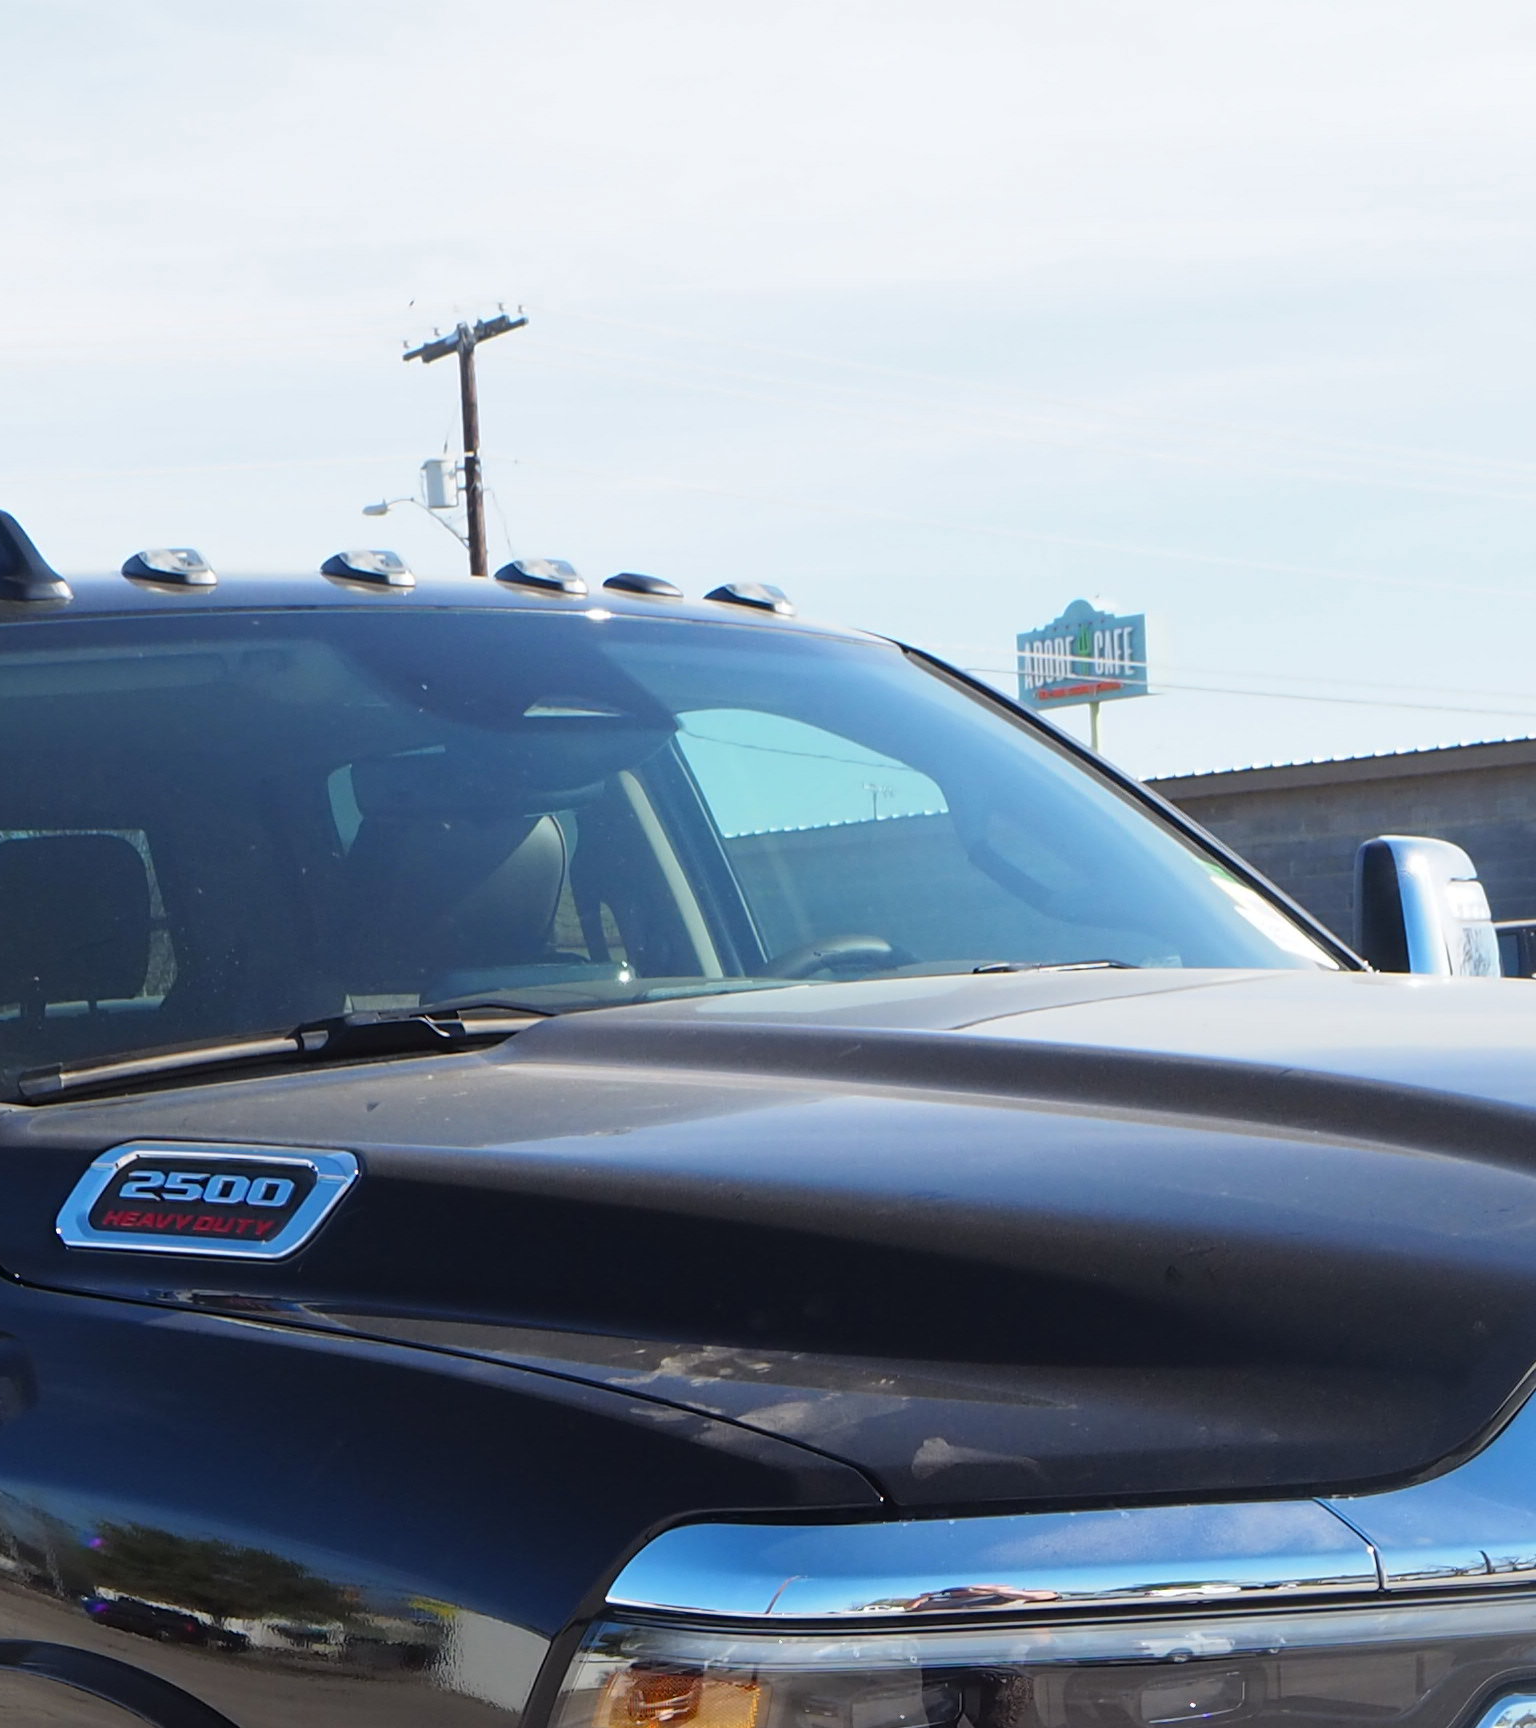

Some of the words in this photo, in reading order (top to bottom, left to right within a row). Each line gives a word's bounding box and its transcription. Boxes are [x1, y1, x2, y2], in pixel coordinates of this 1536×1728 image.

[1024, 636, 1074, 689] ADOBE
[1093, 627, 1135, 675] CAFE
[119, 1170, 295, 1208] 2500
[101, 1210, 193, 1231] HEAVY
[192, 1215, 275, 1236] DUTY
